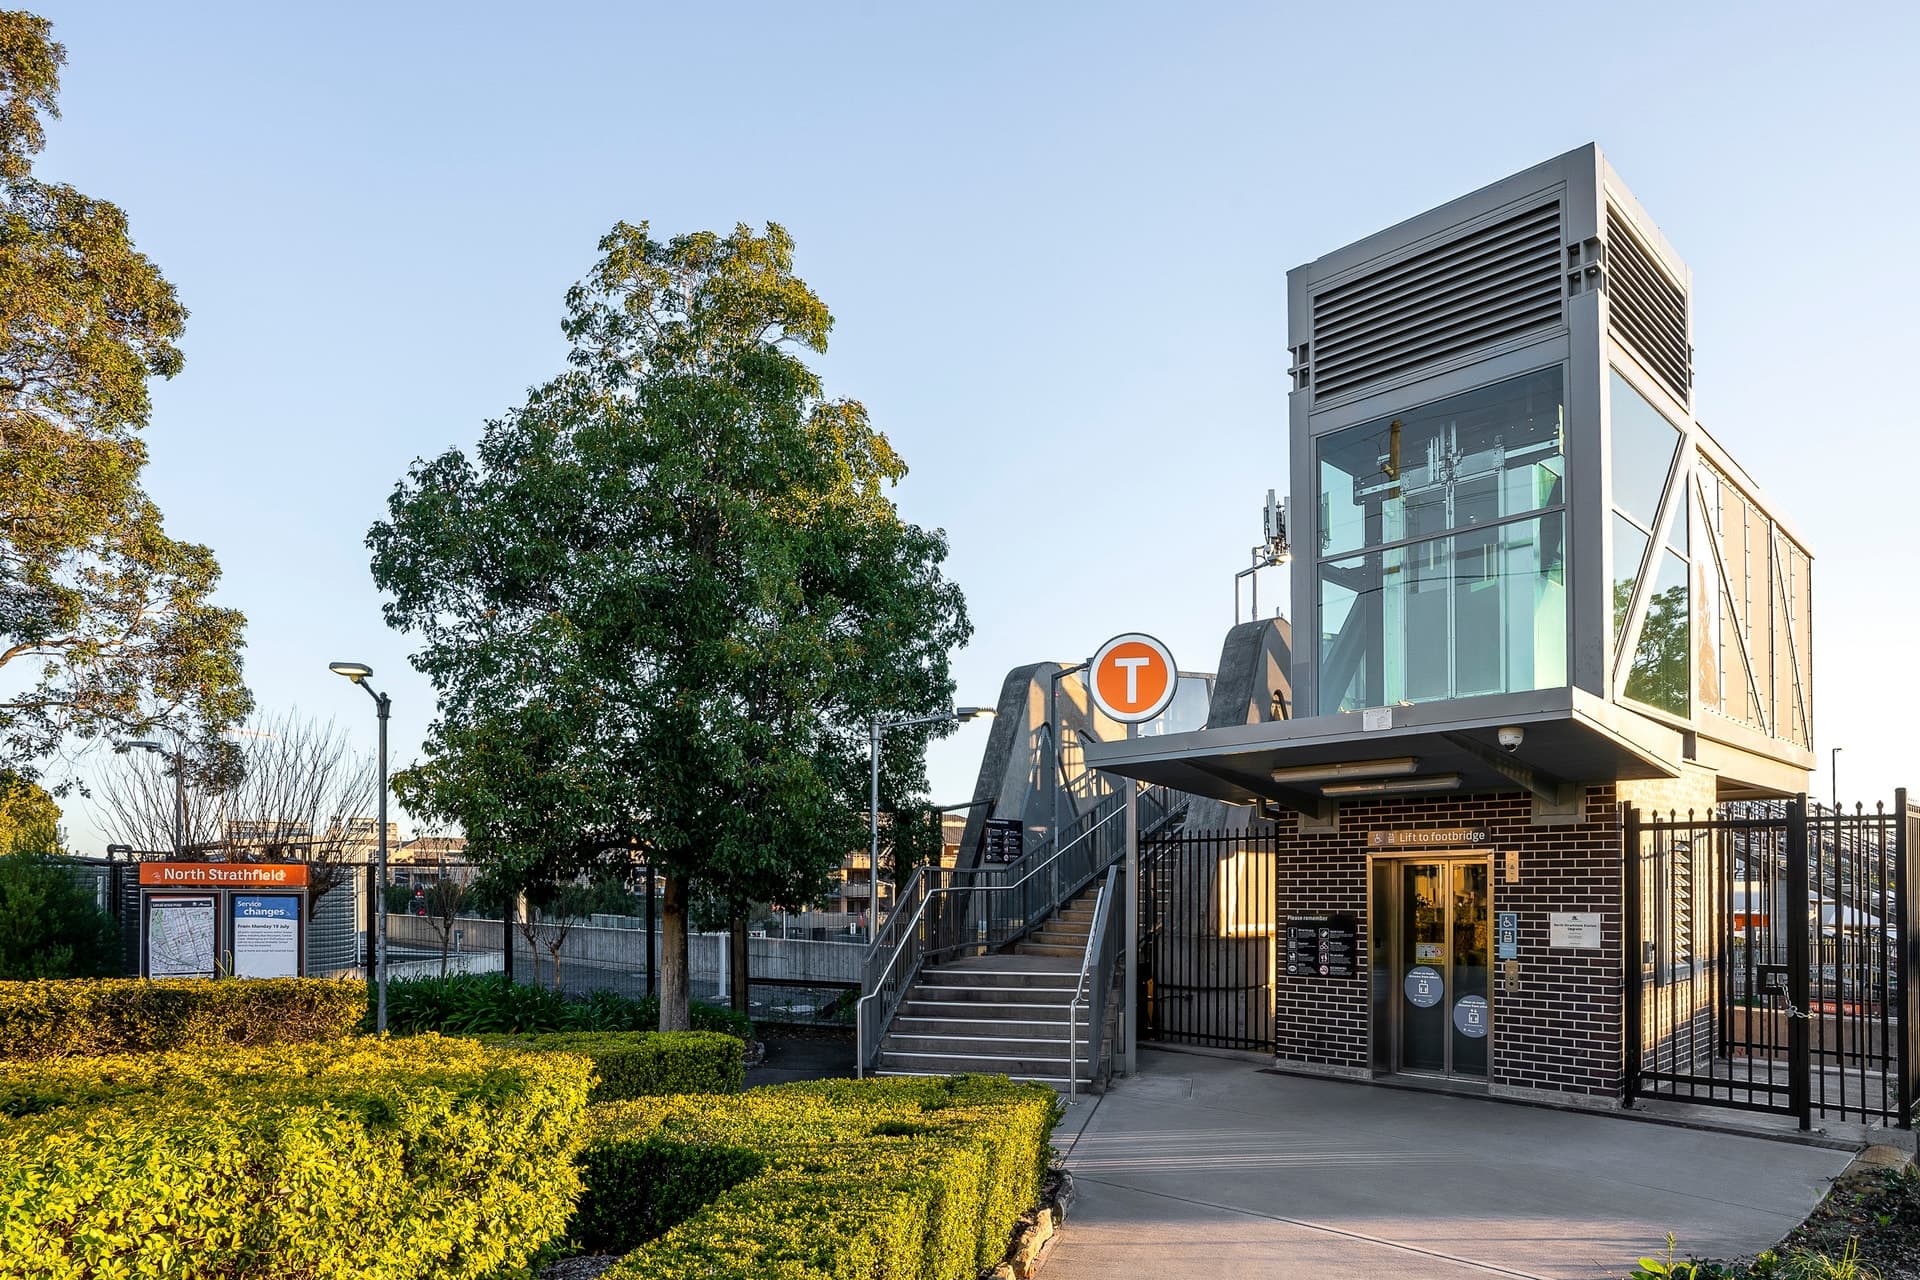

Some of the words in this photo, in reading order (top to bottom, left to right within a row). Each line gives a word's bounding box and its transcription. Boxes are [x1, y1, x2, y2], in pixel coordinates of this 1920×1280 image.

[1114, 657, 1149, 704] T
[1400, 832, 1417, 842] Lift
[1419, 833, 1429, 842] to
[1431, 830, 1486, 843] footbridge
[164, 868, 206, 881] North
[208, 868, 285, 882] Strathfield
[237, 900, 262, 908] Service
[243, 907, 285, 918] changes
[1303, 914, 1328, 922] remember
